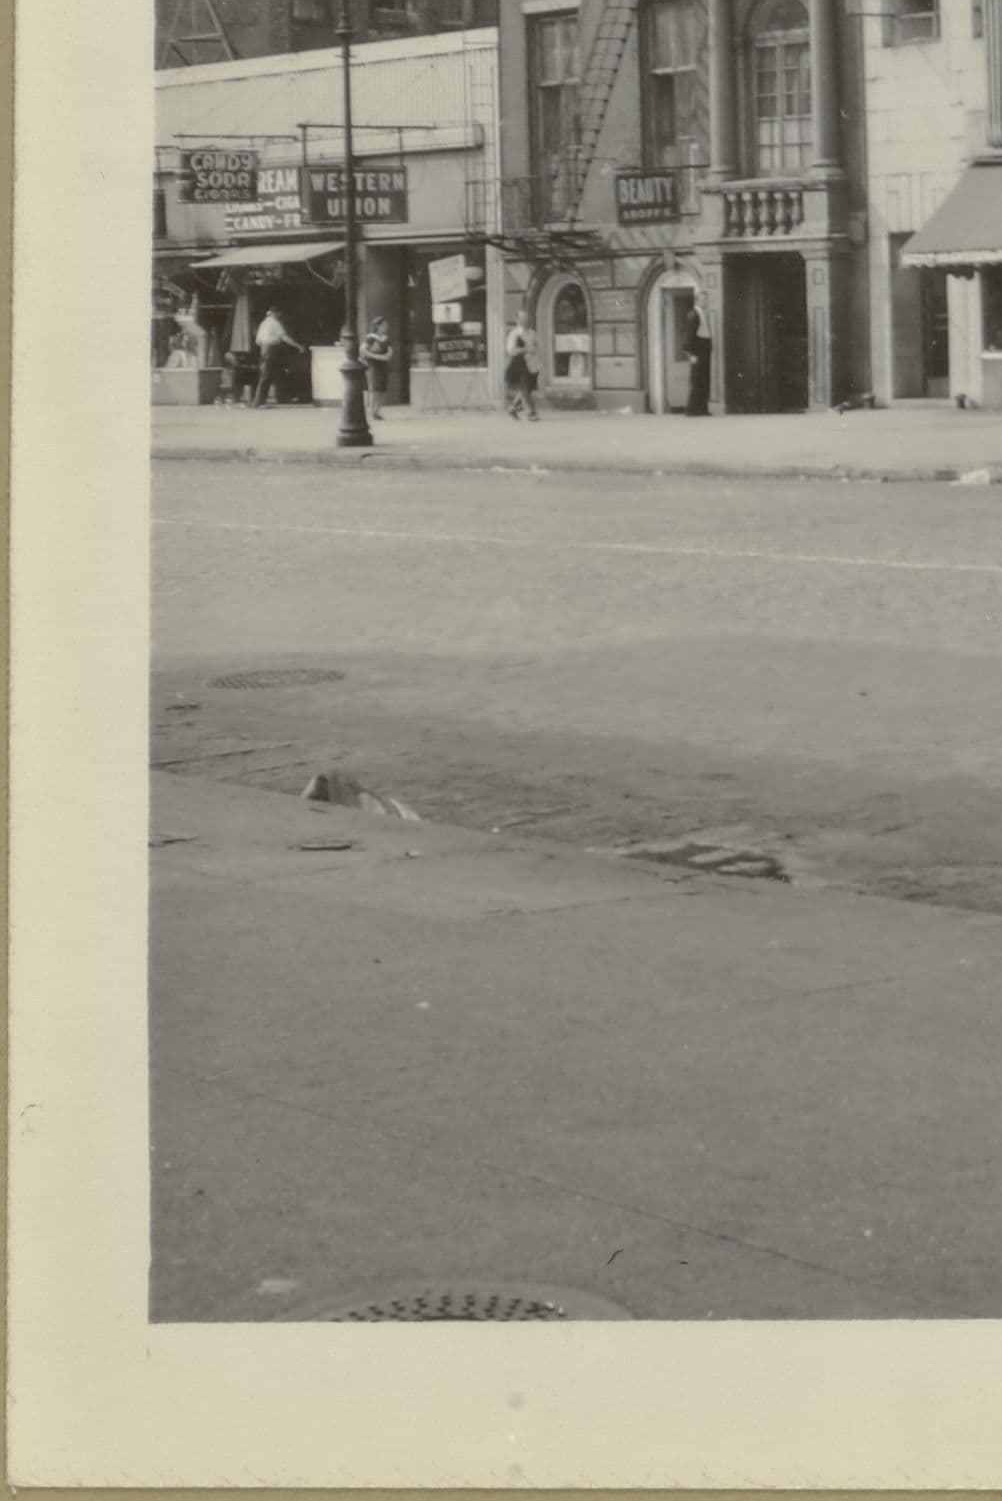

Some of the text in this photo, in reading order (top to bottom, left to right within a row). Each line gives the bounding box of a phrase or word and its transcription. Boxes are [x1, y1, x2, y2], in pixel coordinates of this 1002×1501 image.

[190, 154, 253, 171] CANDY
[196, 171, 249, 188] SODA
[619, 177, 673, 204] BEAUTY
